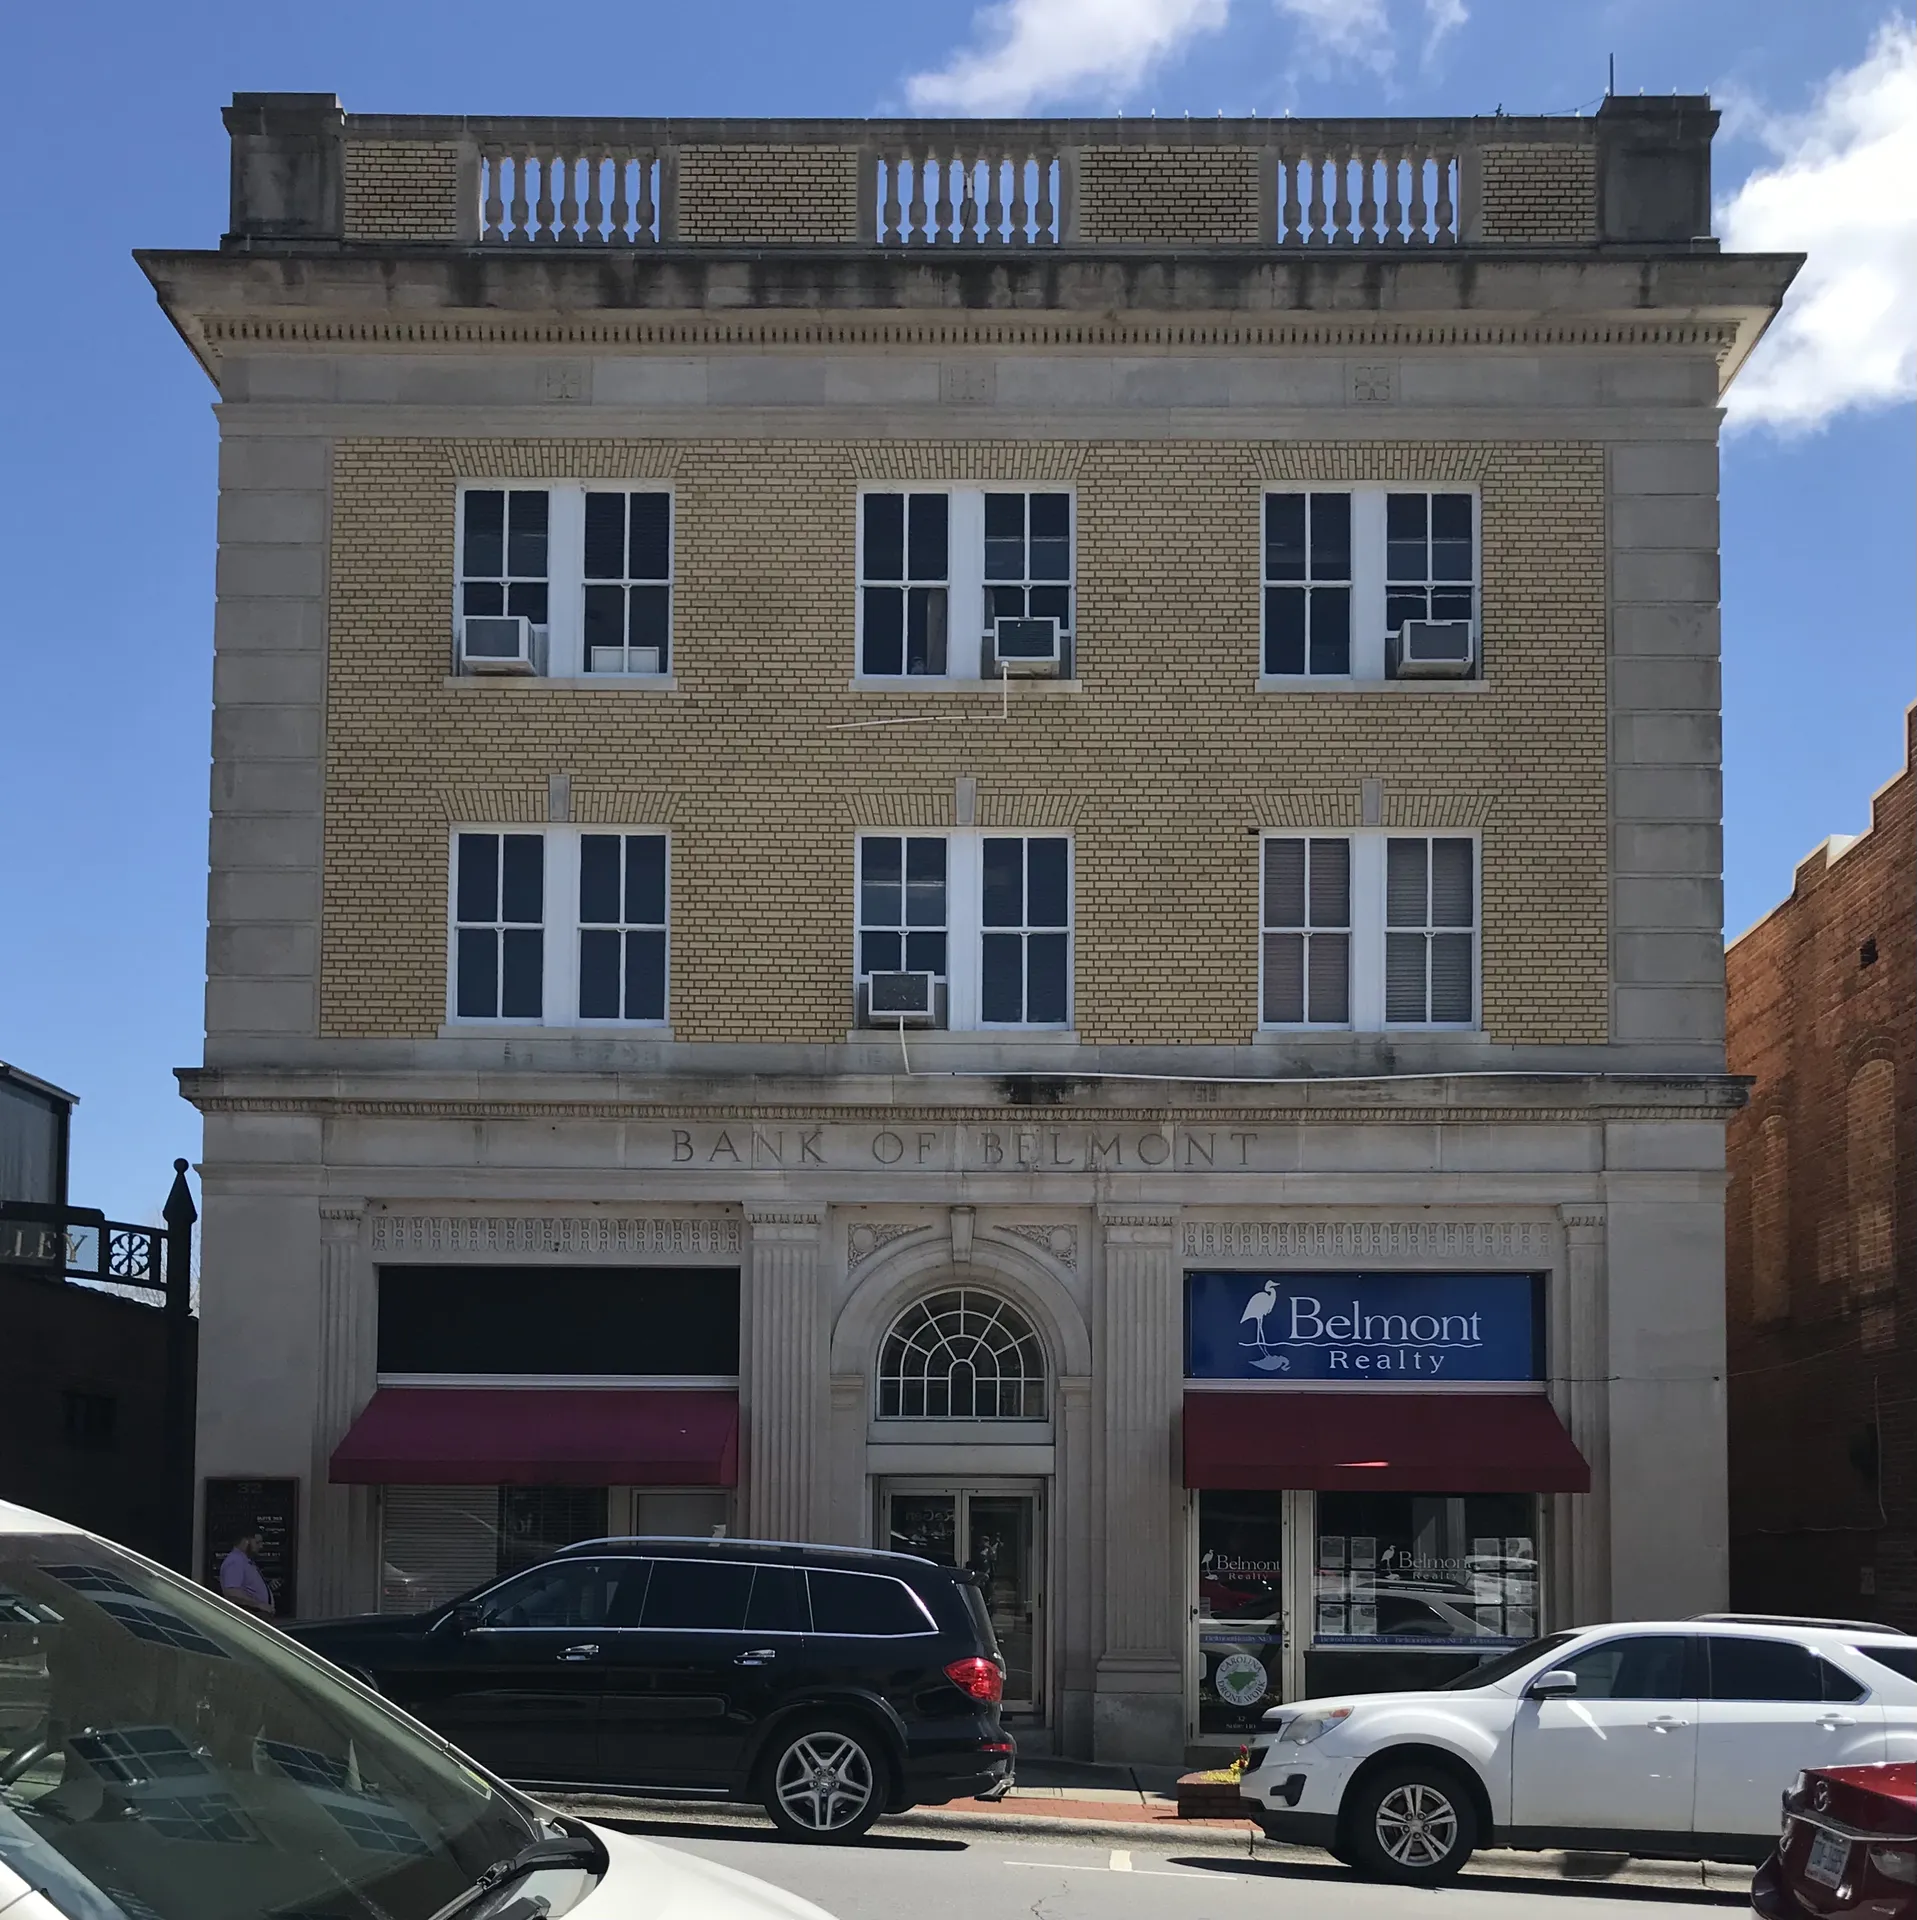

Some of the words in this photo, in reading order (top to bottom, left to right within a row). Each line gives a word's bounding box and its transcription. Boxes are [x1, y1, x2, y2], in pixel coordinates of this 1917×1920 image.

[672, 1128, 828, 1166] BANK
[872, 1129, 938, 1165] OF
[984, 1130, 1259, 1166] BELMONT
[0, 1227, 88, 1264] LEY
[1289, 1296, 1482, 1342] Belmont
[1329, 1350, 1445, 1374] Realty
[1217, 1554, 1281, 1570] Belmont
[1229, 1573, 1269, 1581] Realty
[1412, 1572, 1458, 1581] Realty
[1220, 1656, 1263, 1673] CAROLINA
[1217, 1680, 1242, 1703] DRONE
[1243, 1680, 1266, 1703] WORK
